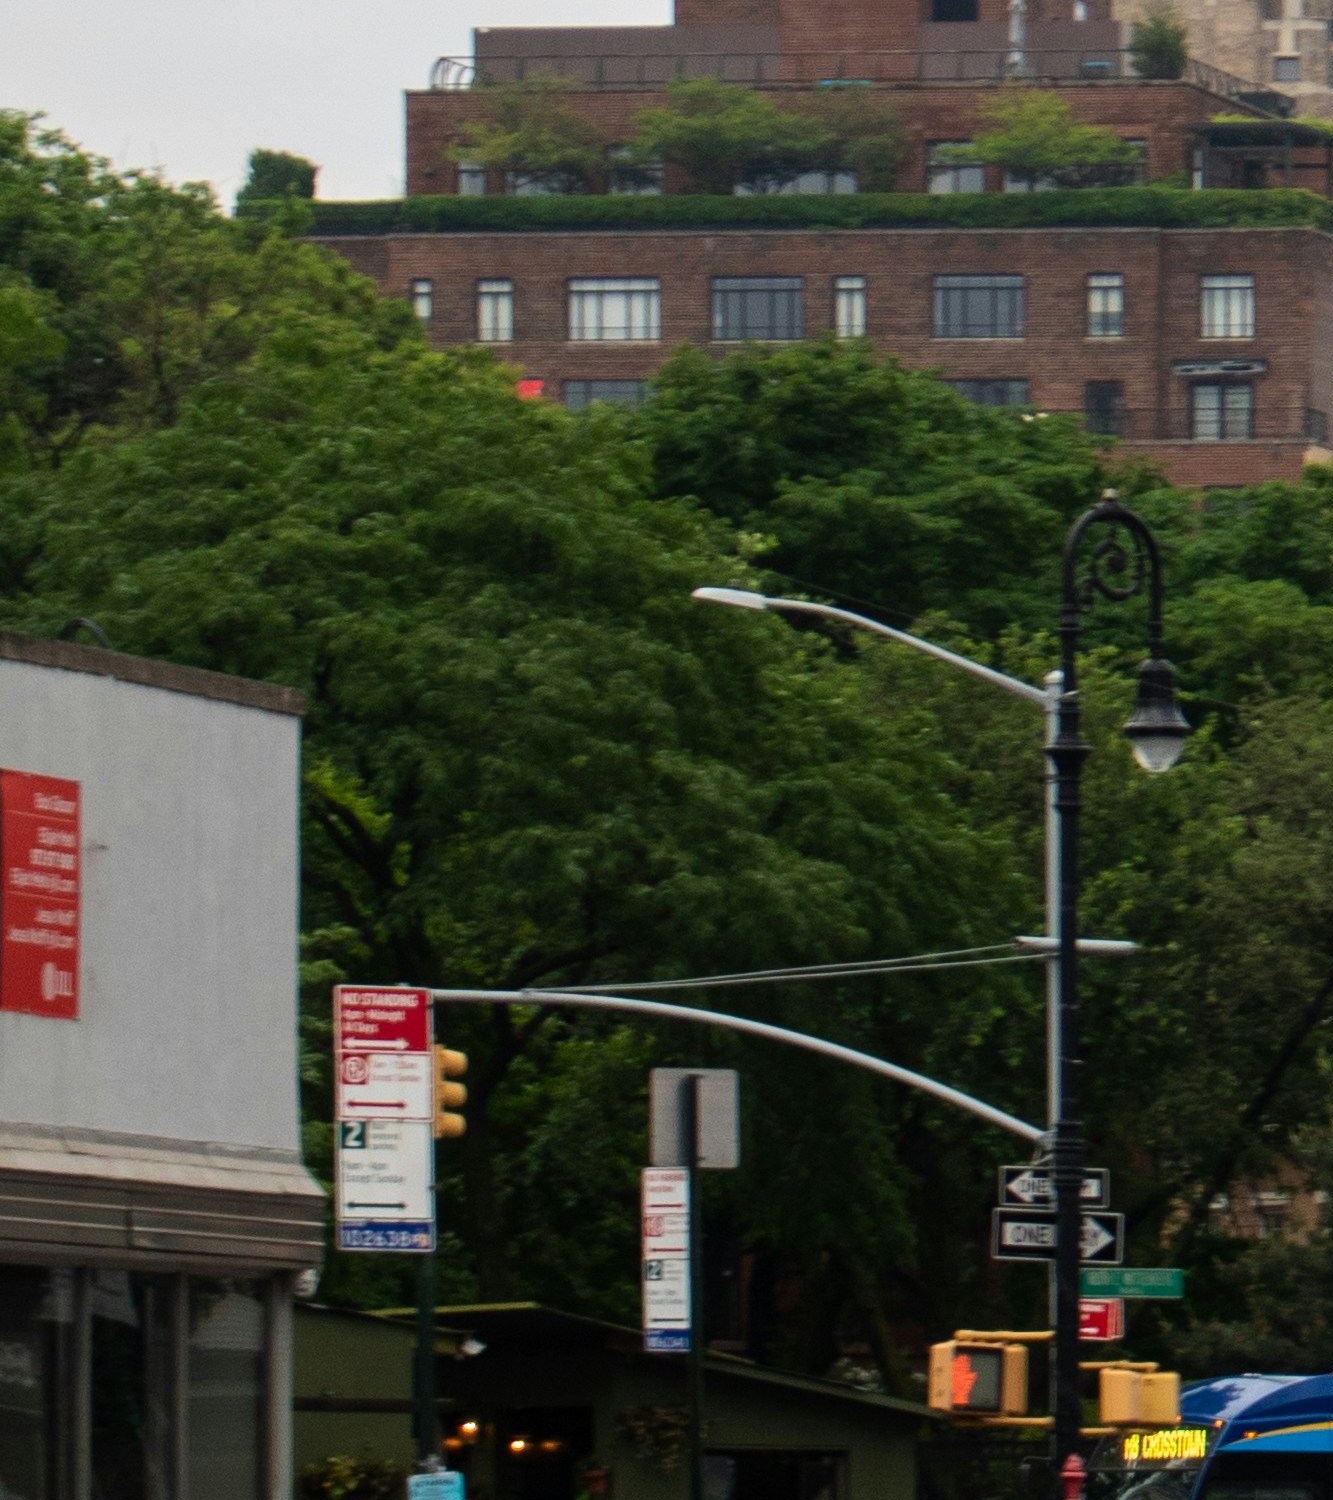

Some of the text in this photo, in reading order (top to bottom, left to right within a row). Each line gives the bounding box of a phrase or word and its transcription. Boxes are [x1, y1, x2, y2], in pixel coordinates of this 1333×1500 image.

[344, 1121, 363, 1147] 2
[1019, 1179, 1049, 1194] ONE
[1012, 1225, 1050, 1245] ONE
[1141, 1429, 1207, 1460] CROSSTOWN
